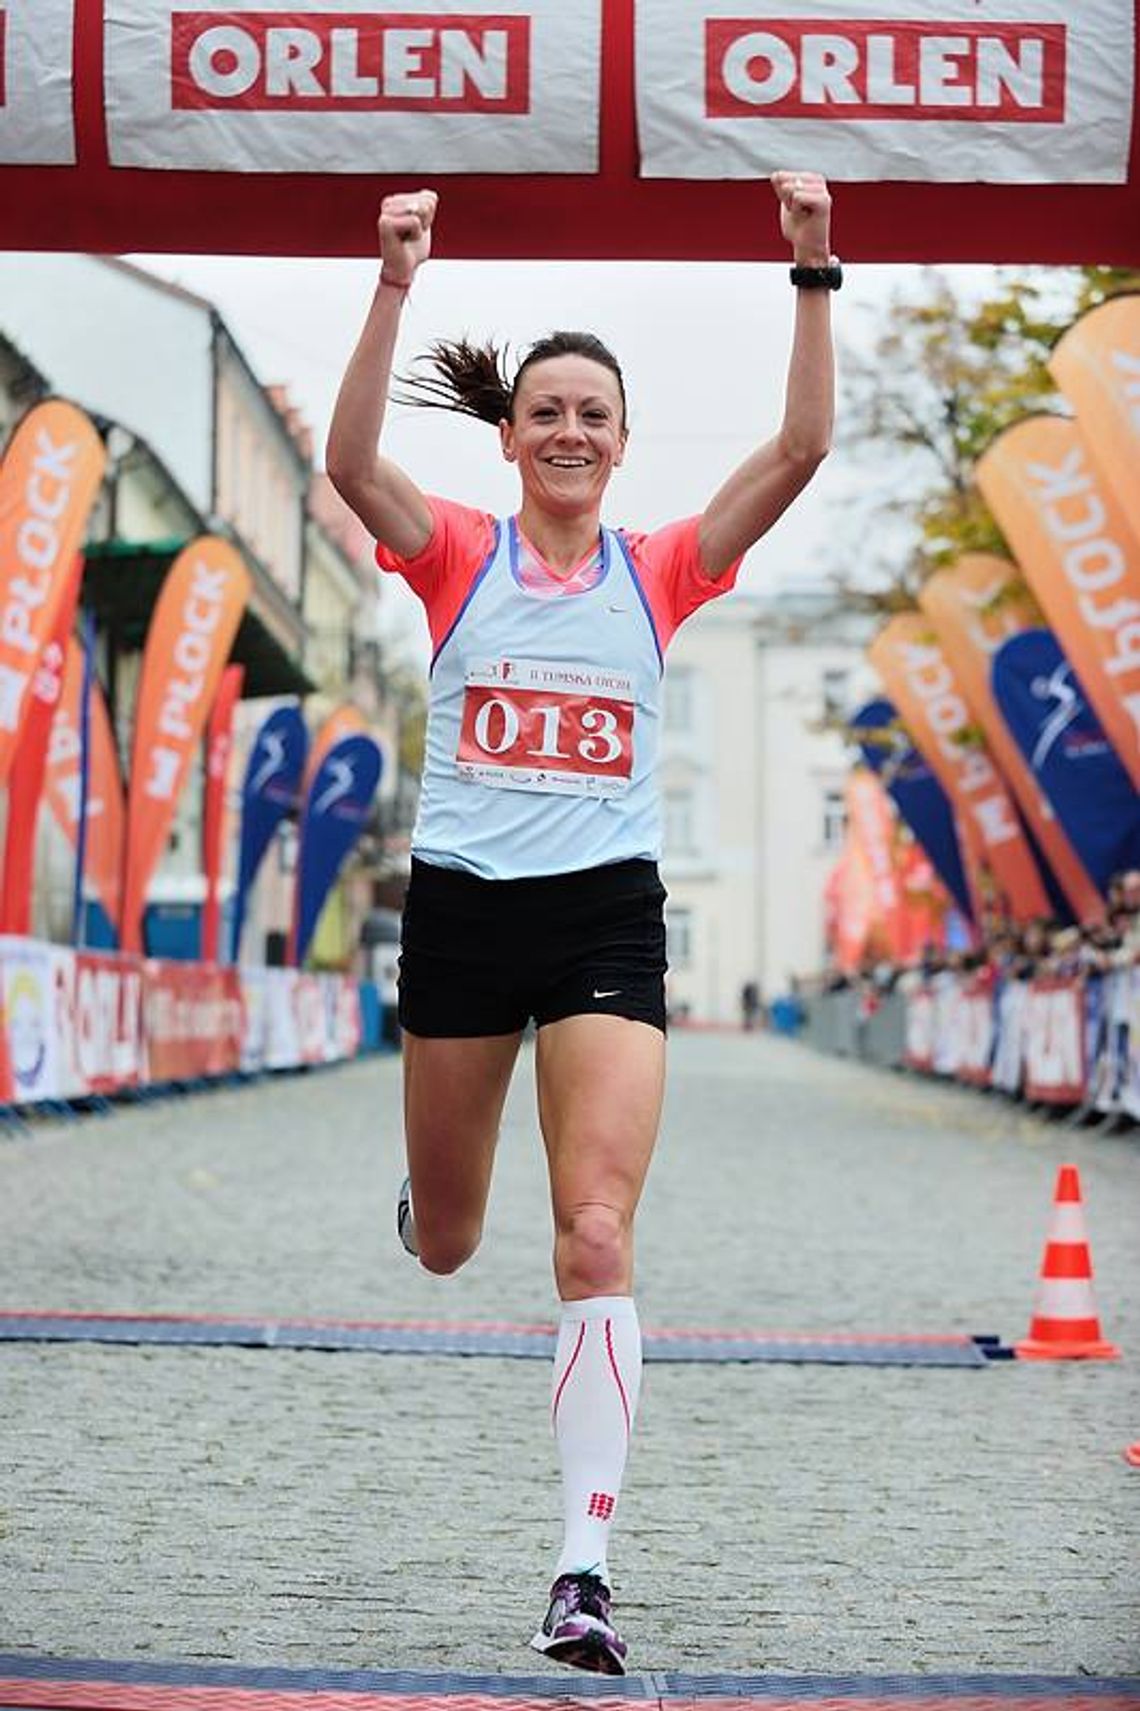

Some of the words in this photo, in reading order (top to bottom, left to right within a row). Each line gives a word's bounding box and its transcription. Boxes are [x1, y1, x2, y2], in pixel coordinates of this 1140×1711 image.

[189, 25, 508, 99] ORLEN
[722, 32, 1043, 107] ORLEN
[3, 426, 78, 653] PŁOCK
[158, 560, 228, 740] PŁOCK
[475, 698, 622, 764] 013
